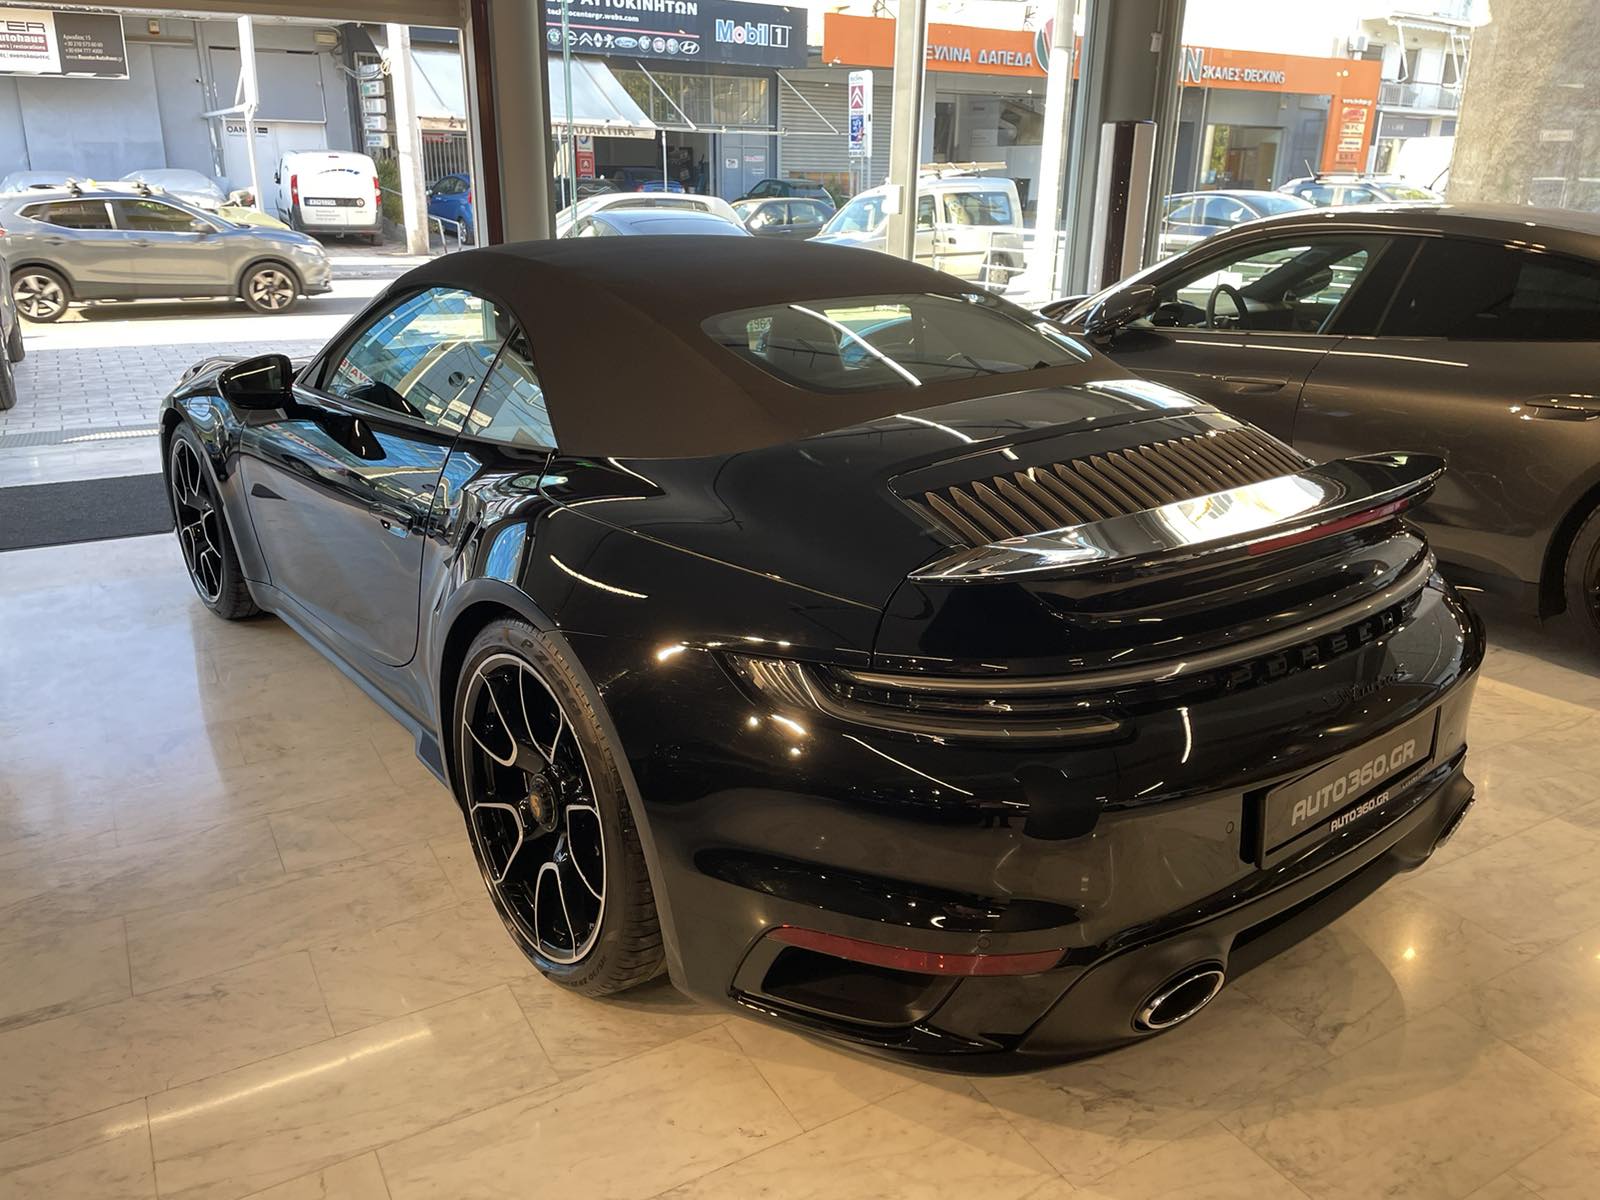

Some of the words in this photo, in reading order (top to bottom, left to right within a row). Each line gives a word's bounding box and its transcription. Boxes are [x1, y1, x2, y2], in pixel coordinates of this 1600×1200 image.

[547, 8, 640, 22] techocentergr.webs.com
[0, 20, 46, 32] ER
[716, 18, 769, 46] Mobil
[0, 34, 45, 44] utohaus
[978, 50, 1033, 67] ΔΑΠΕΔΑ
[1291, 738, 1416, 827] AUTO360.GR
[1330, 791, 1389, 833] AUTO360.GR
